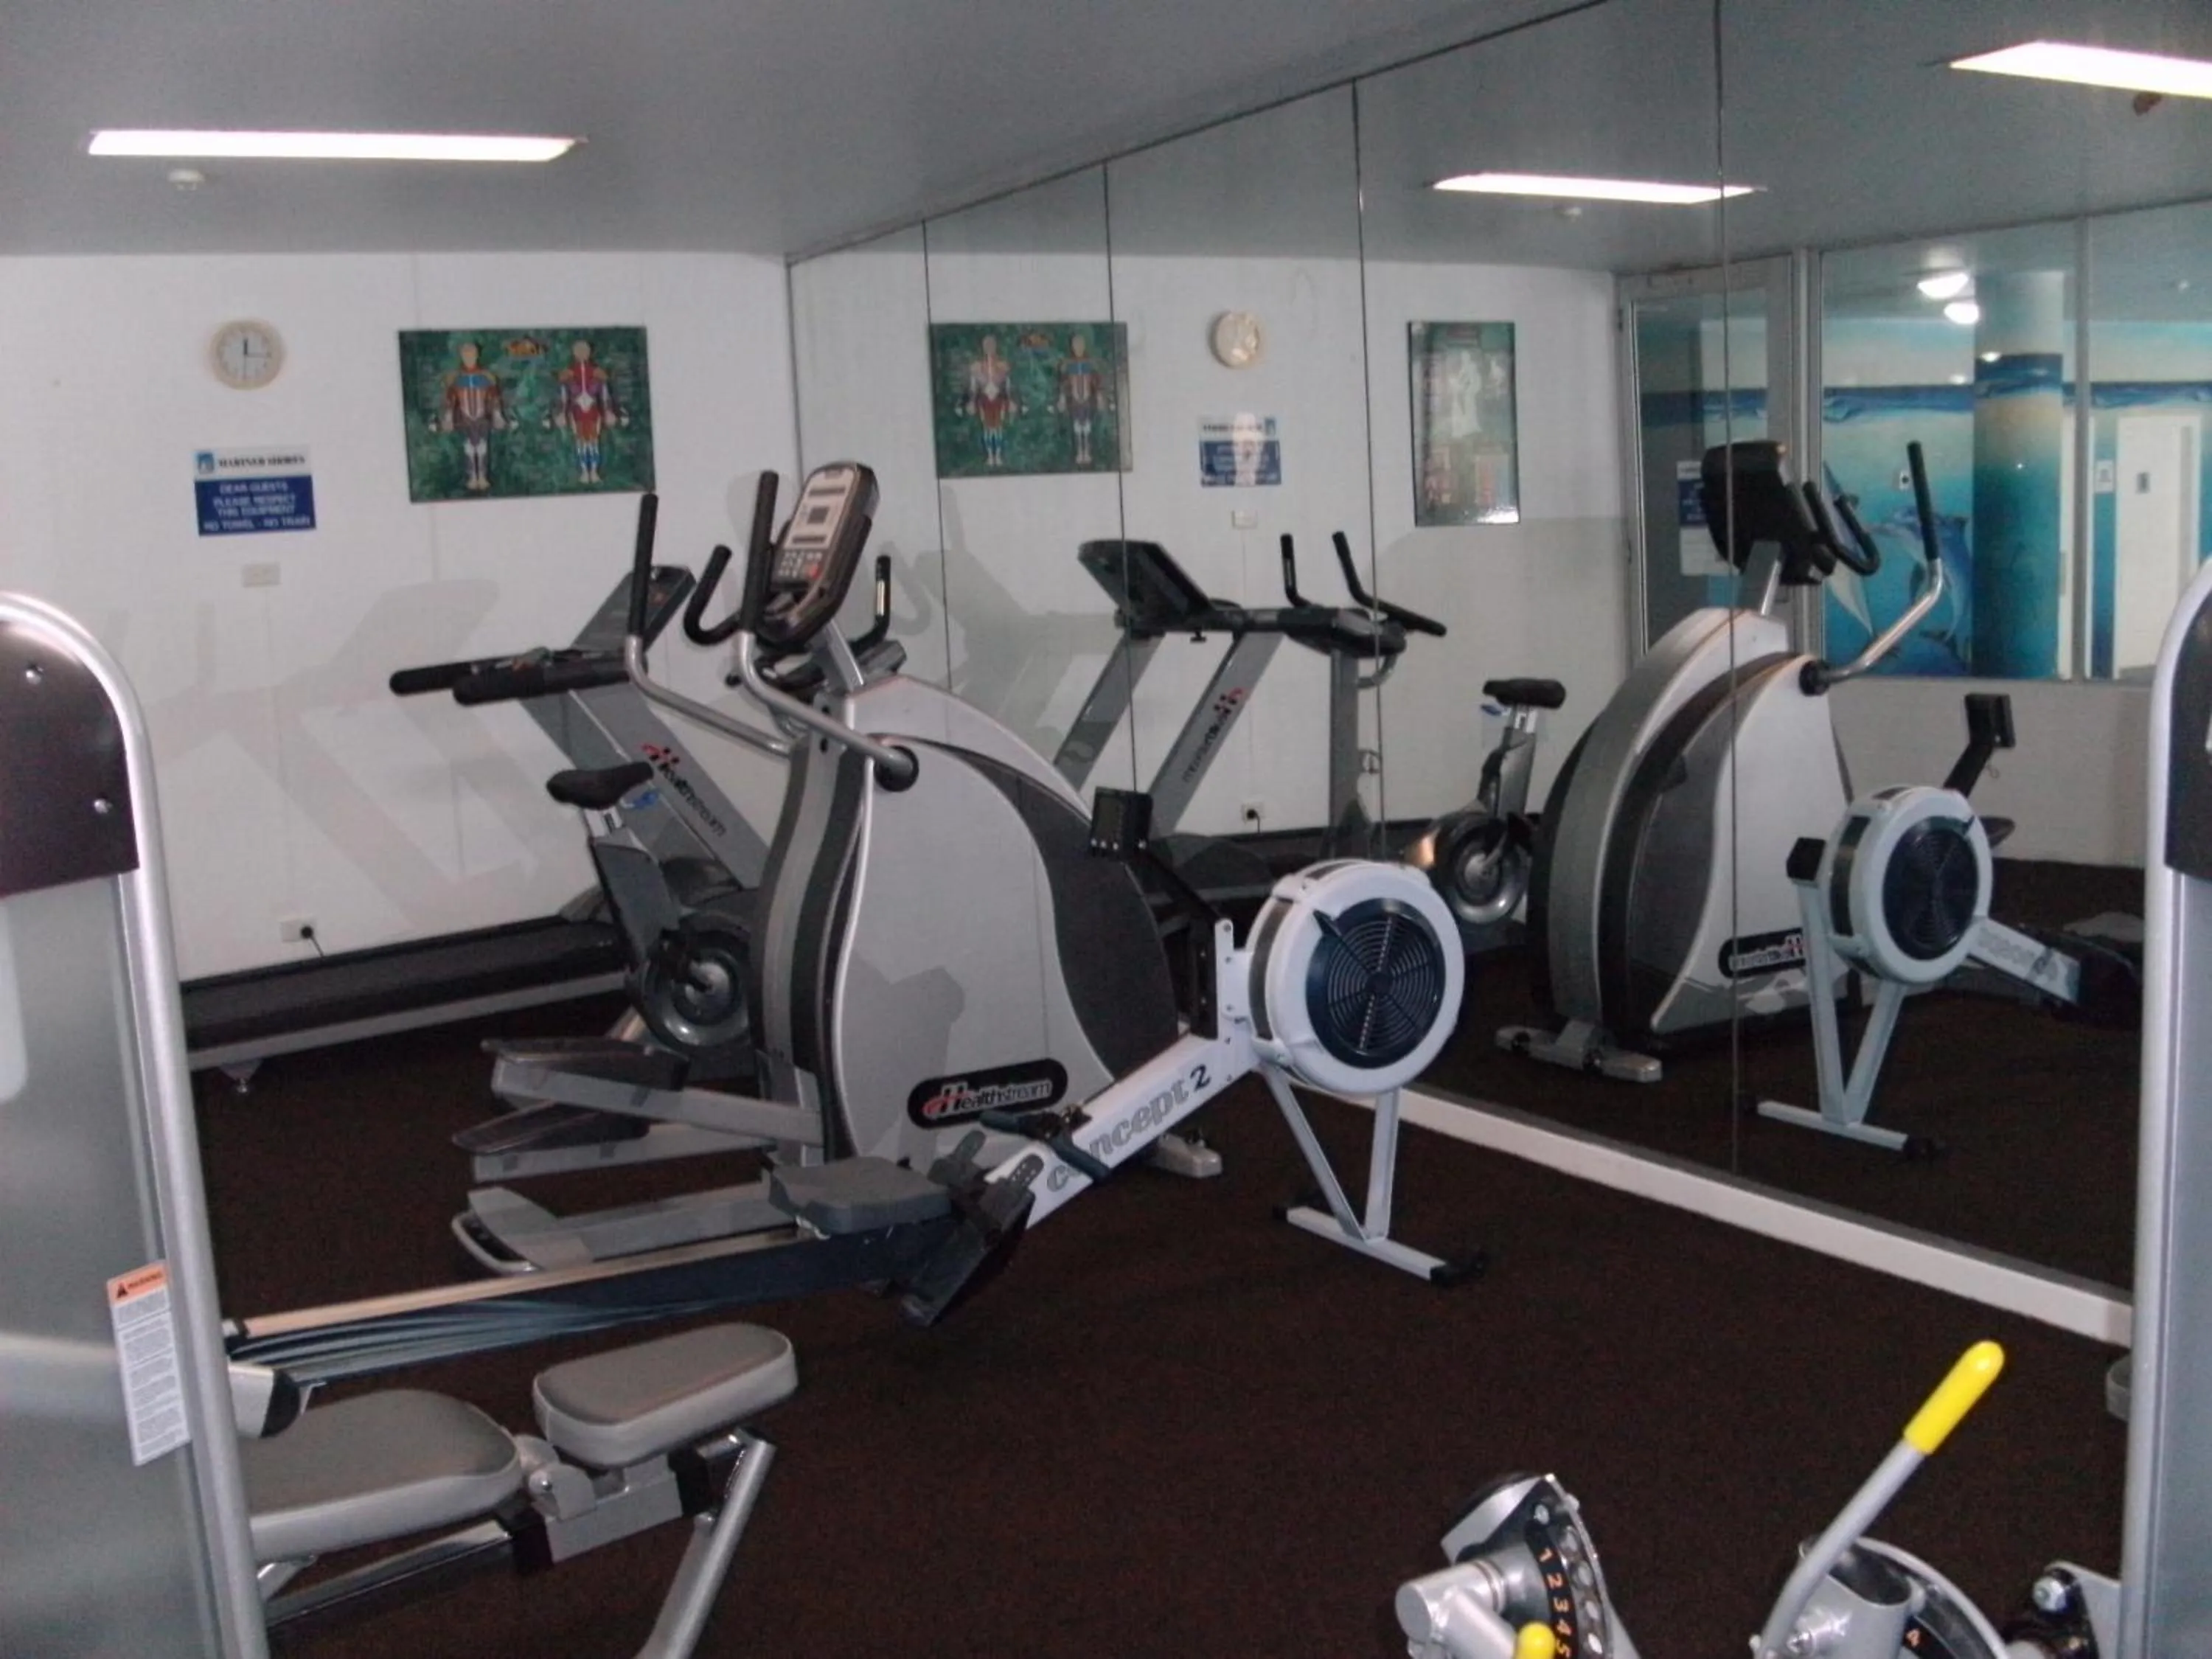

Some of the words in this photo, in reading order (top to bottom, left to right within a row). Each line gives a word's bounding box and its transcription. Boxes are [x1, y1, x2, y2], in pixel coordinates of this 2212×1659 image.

[1189, 1064, 1213, 1093] 2
[923, 1079, 1052, 1118] Healthstream
[1539, 1548, 1554, 1562] 1
[1546, 1573, 1563, 1588] 2
[1553, 1597, 1570, 1613] 3
[1557, 1619, 1572, 1636] 4
[1556, 1639, 1572, 1659] 5
